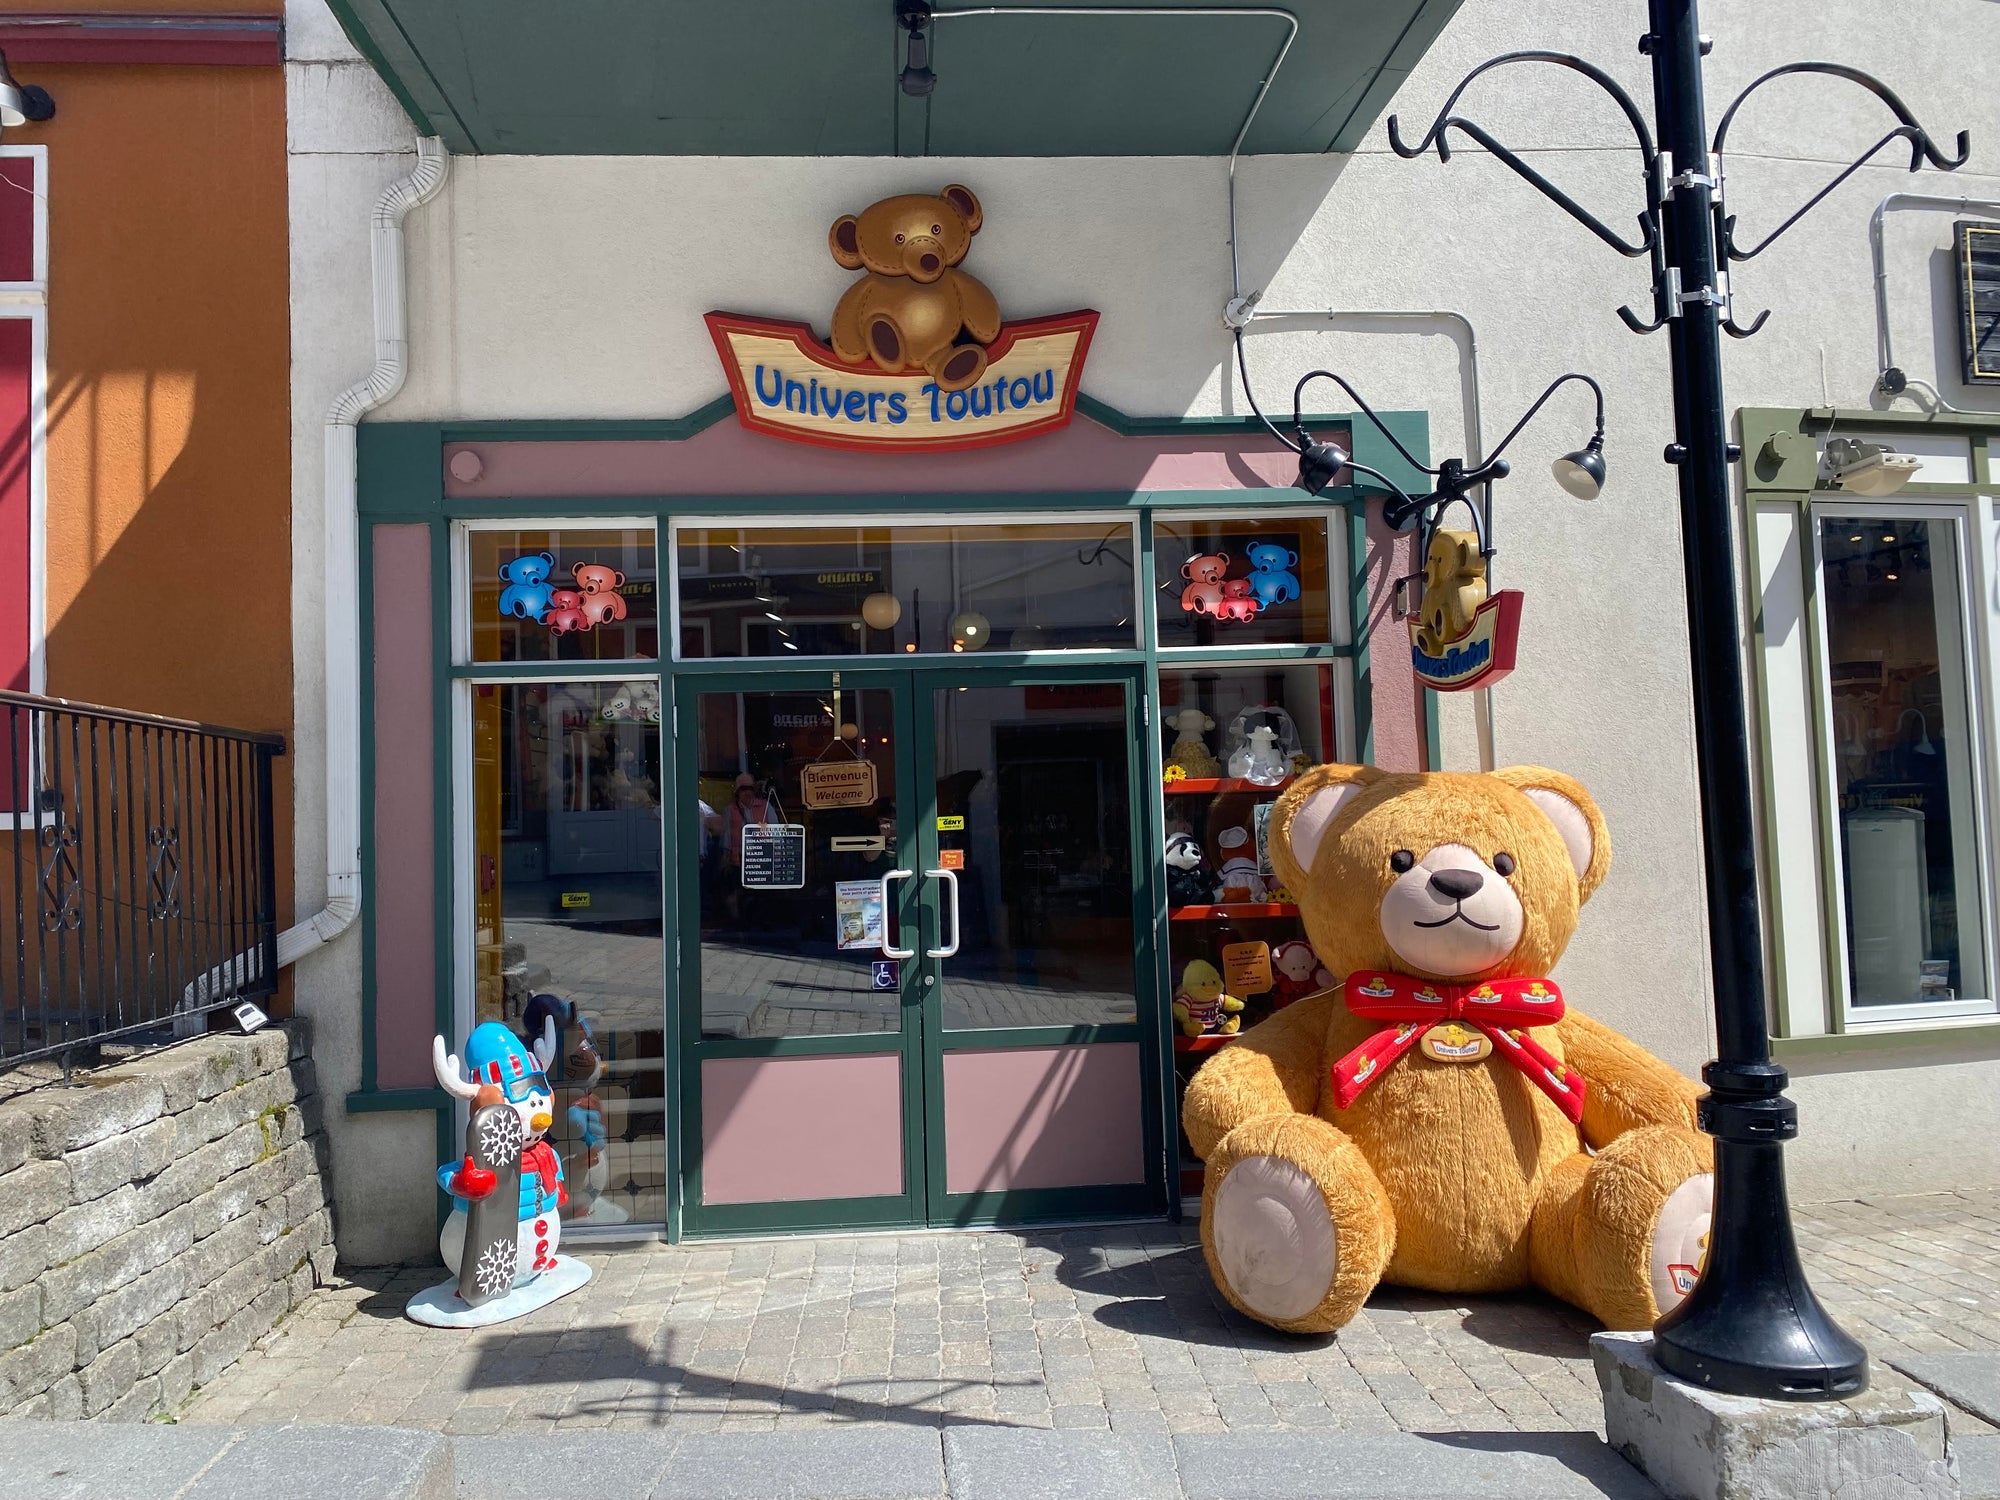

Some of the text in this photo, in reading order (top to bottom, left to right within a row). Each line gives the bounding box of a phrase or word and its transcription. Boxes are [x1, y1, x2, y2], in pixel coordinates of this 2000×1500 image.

[755, 365, 1054, 424] Univers Toutou
[807, 772, 869, 783] Bienvenue
[816, 791, 863, 801] Welcome
[1436, 1045, 1478, 1055] Univers Toutou
